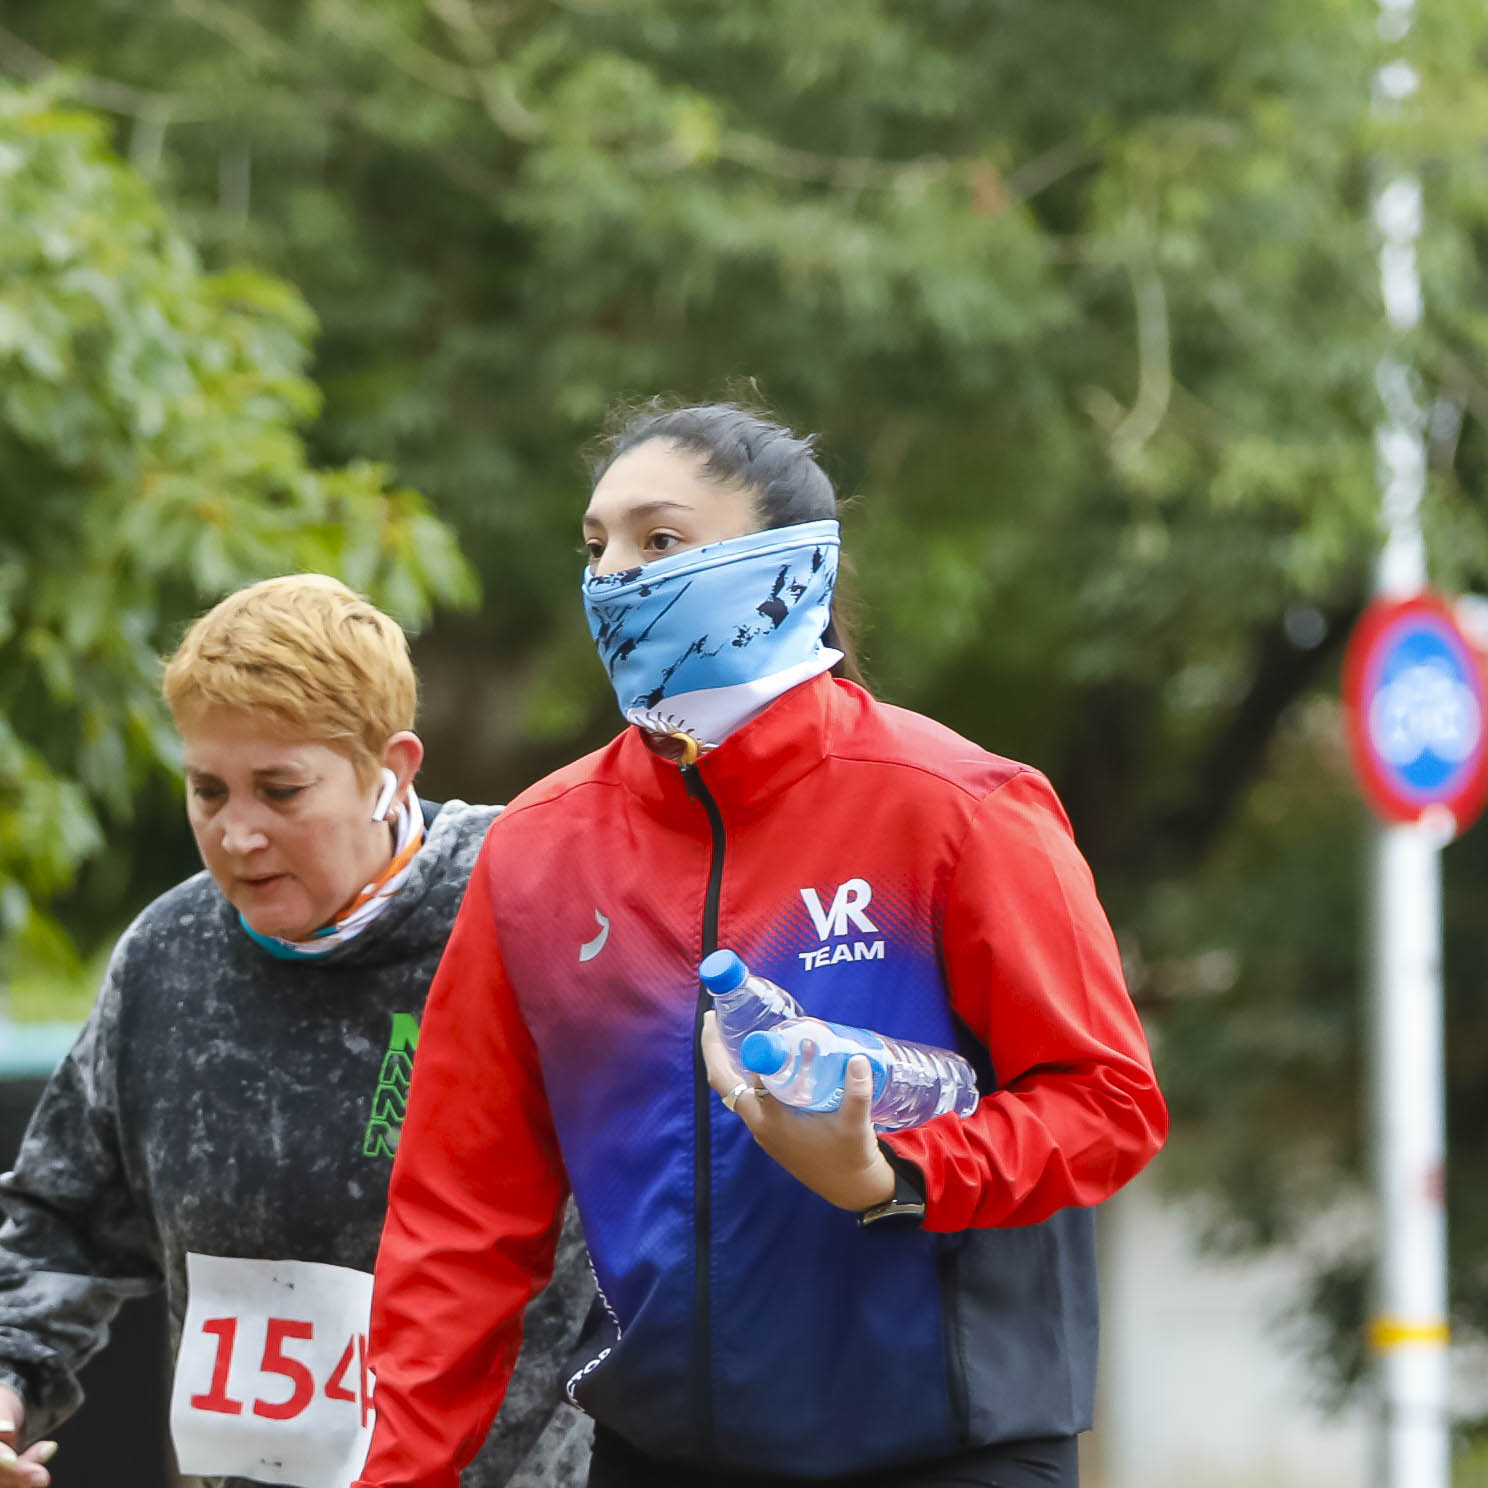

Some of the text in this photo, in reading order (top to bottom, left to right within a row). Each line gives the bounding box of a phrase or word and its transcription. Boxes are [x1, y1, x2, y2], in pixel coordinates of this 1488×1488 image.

[799, 877, 880, 942] VR
[798, 940, 886, 972] TEAM
[190, 1316, 375, 1428] 154
